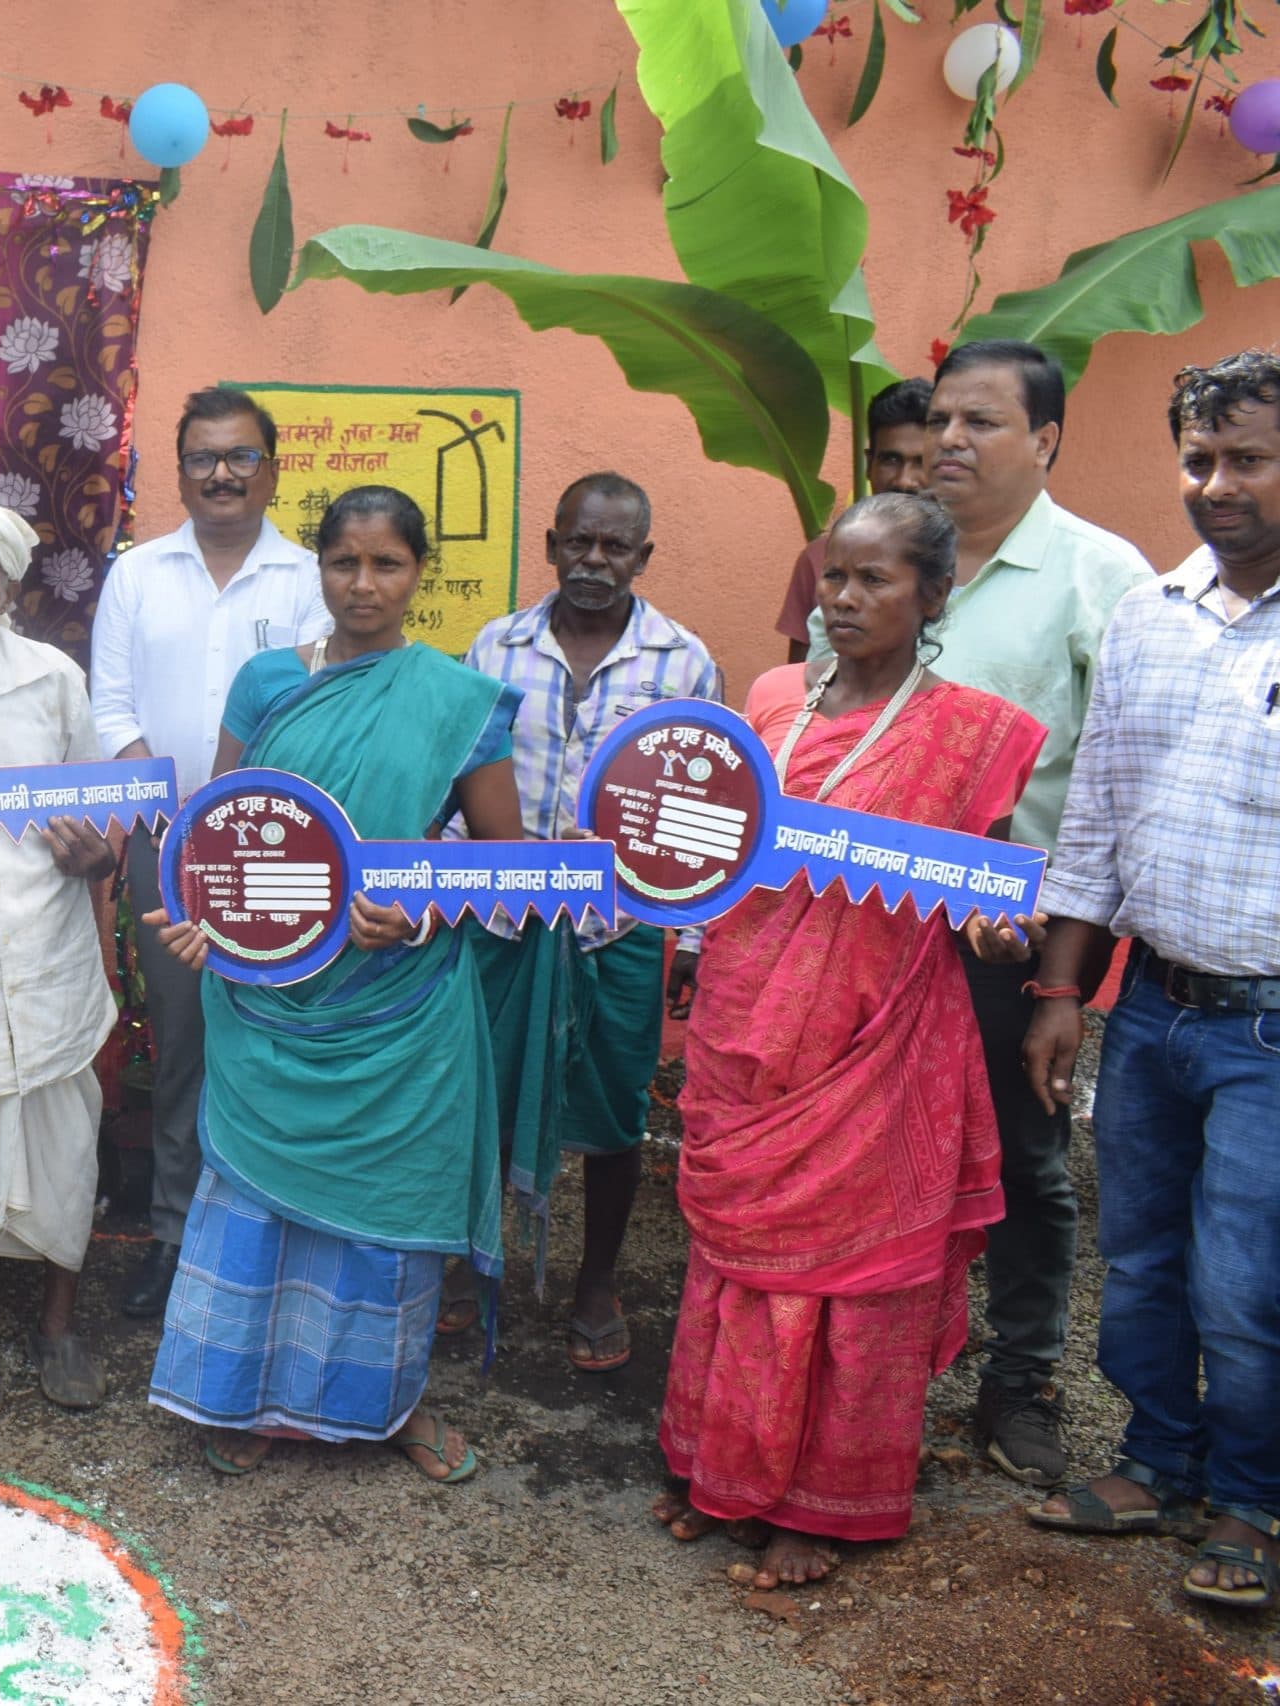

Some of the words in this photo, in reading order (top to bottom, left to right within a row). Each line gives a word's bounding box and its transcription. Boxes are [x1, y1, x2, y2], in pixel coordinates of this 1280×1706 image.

[637, 729, 670, 756] शुभ
[672, 727, 705, 748] गृह
[703, 732, 743, 771] प्रवेश
[32, 787, 79, 808] जनमन
[82, 784, 123, 805] आवास
[125, 777, 168, 800] योजना
[205, 800, 234, 830] शुभ
[237, 796, 267, 816] गृह
[271, 799, 312, 829] प्रवेश
[628, 838, 658, 855] जिला
[362, 860, 432, 893] प्रधानमंत्री
[435, 869, 492, 890] जनमन
[495, 869, 547, 890] आवास
[550, 862, 603, 891] योजना
[774, 825, 849, 861] प्रधानमंत्री
[850, 842, 910, 875] जनमन
[909, 855, 966, 888] आवास
[968, 862, 1028, 902] योजना
[222, 910, 252, 922] जिला
